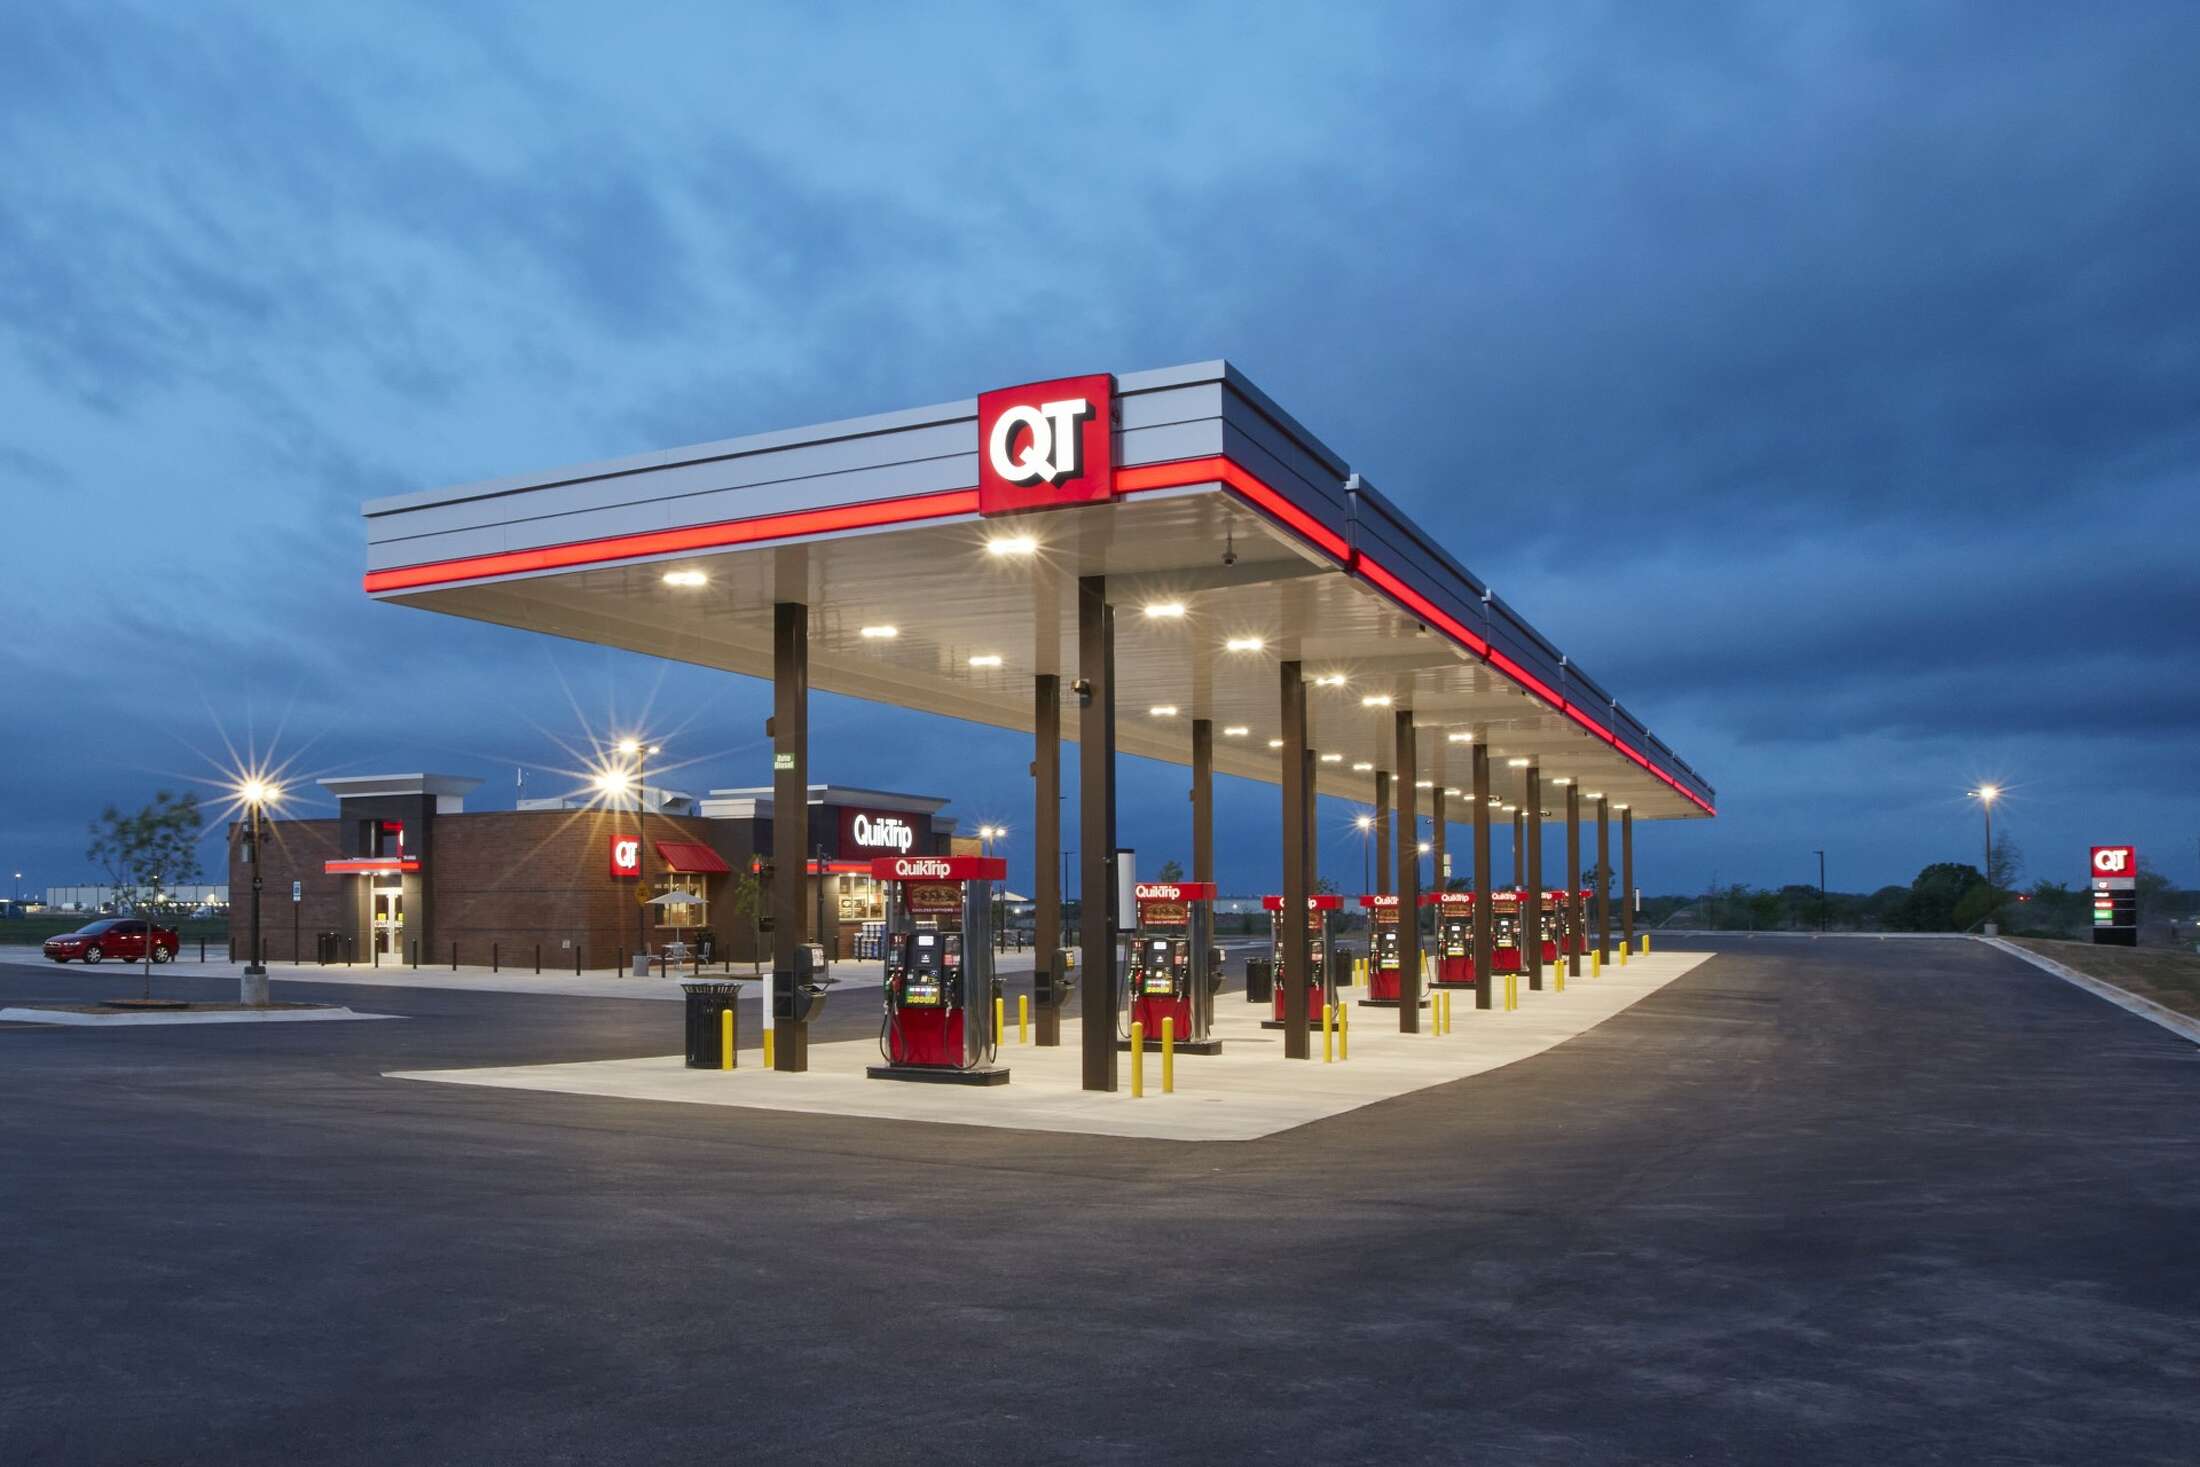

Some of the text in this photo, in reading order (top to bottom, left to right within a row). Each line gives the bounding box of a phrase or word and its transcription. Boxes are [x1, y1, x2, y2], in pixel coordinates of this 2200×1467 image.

[989, 397, 1088, 484] QT
[853, 814, 913, 854] QuikTrip
[615, 841, 638, 869] QT
[2094, 850, 2128, 871] QT
[895, 859, 951, 879] QuikTrip
[1135, 885, 1181, 900] QuikTrip
[1441, 893, 1470, 902] QuikTrip
[1491, 892, 1517, 901] QuikTrip
